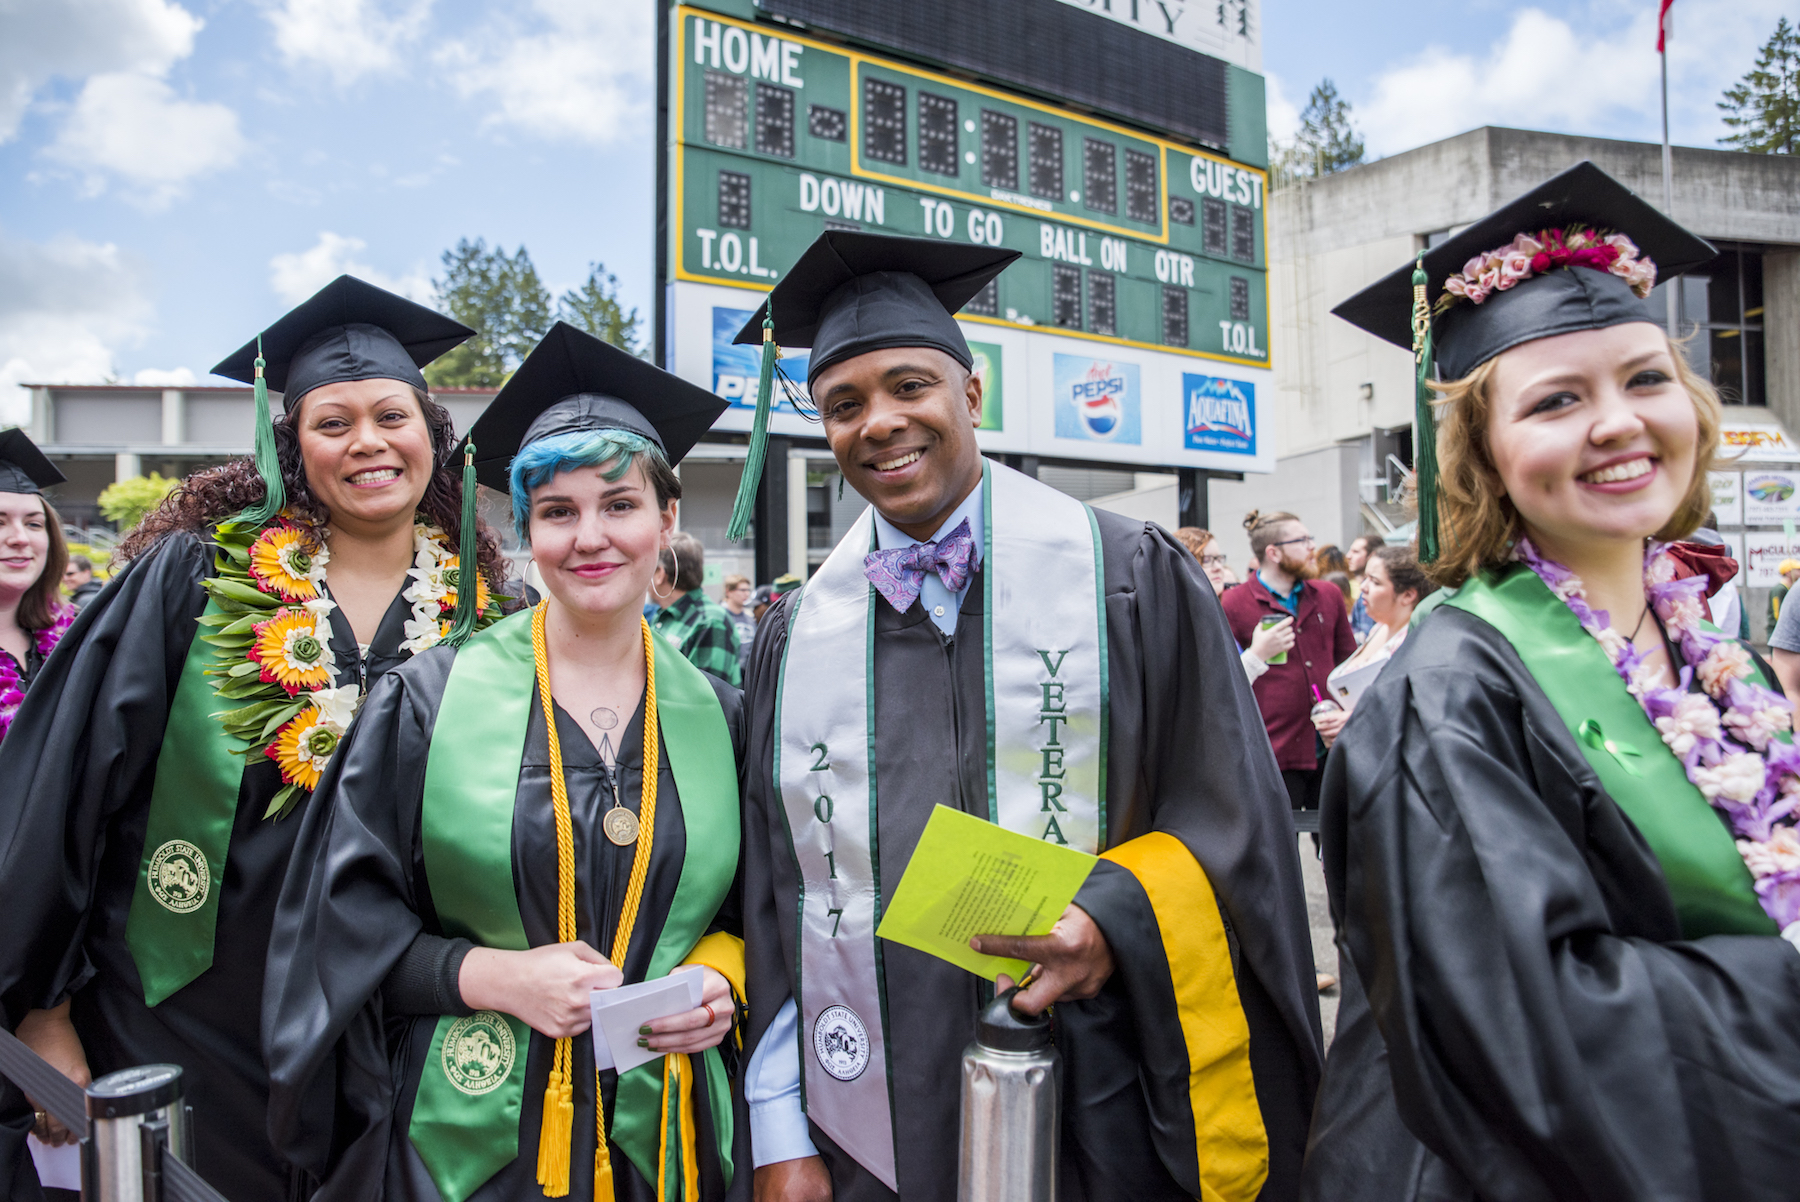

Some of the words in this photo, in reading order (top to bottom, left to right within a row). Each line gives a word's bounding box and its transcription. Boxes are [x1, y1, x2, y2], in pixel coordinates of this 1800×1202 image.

[694, 17, 804, 89] HOME
[799, 173, 885, 225] DOWN
[1190, 155, 1263, 209] GUEST
[919, 197, 954, 238] TO
[967, 208, 1003, 247] GO
[696, 228, 778, 279] T.O.L.
[1040, 223, 1093, 266] BALL
[1100, 237, 1127, 273] ON
[1219, 320, 1266, 358] T.O.L.
[1072, 377, 1124, 401] PEPSI
[1187, 389, 1253, 437] AQUAFINA
[809, 742, 843, 938] 2017
[151, 845, 175, 879] HUMBOLDT
[175, 845, 194, 856] STATE
[194, 854, 207, 895] UNIVERSITY
[446, 1017, 473, 1057] HUMBOLDT
[475, 1013, 495, 1024] STATE
[495, 1021, 511, 1068] UNIVERSITY
[817, 1014, 831, 1054] HUMBOLDT
[831, 1011, 848, 1019] STATE
[849, 1016, 866, 1059] UNIVERSITY
